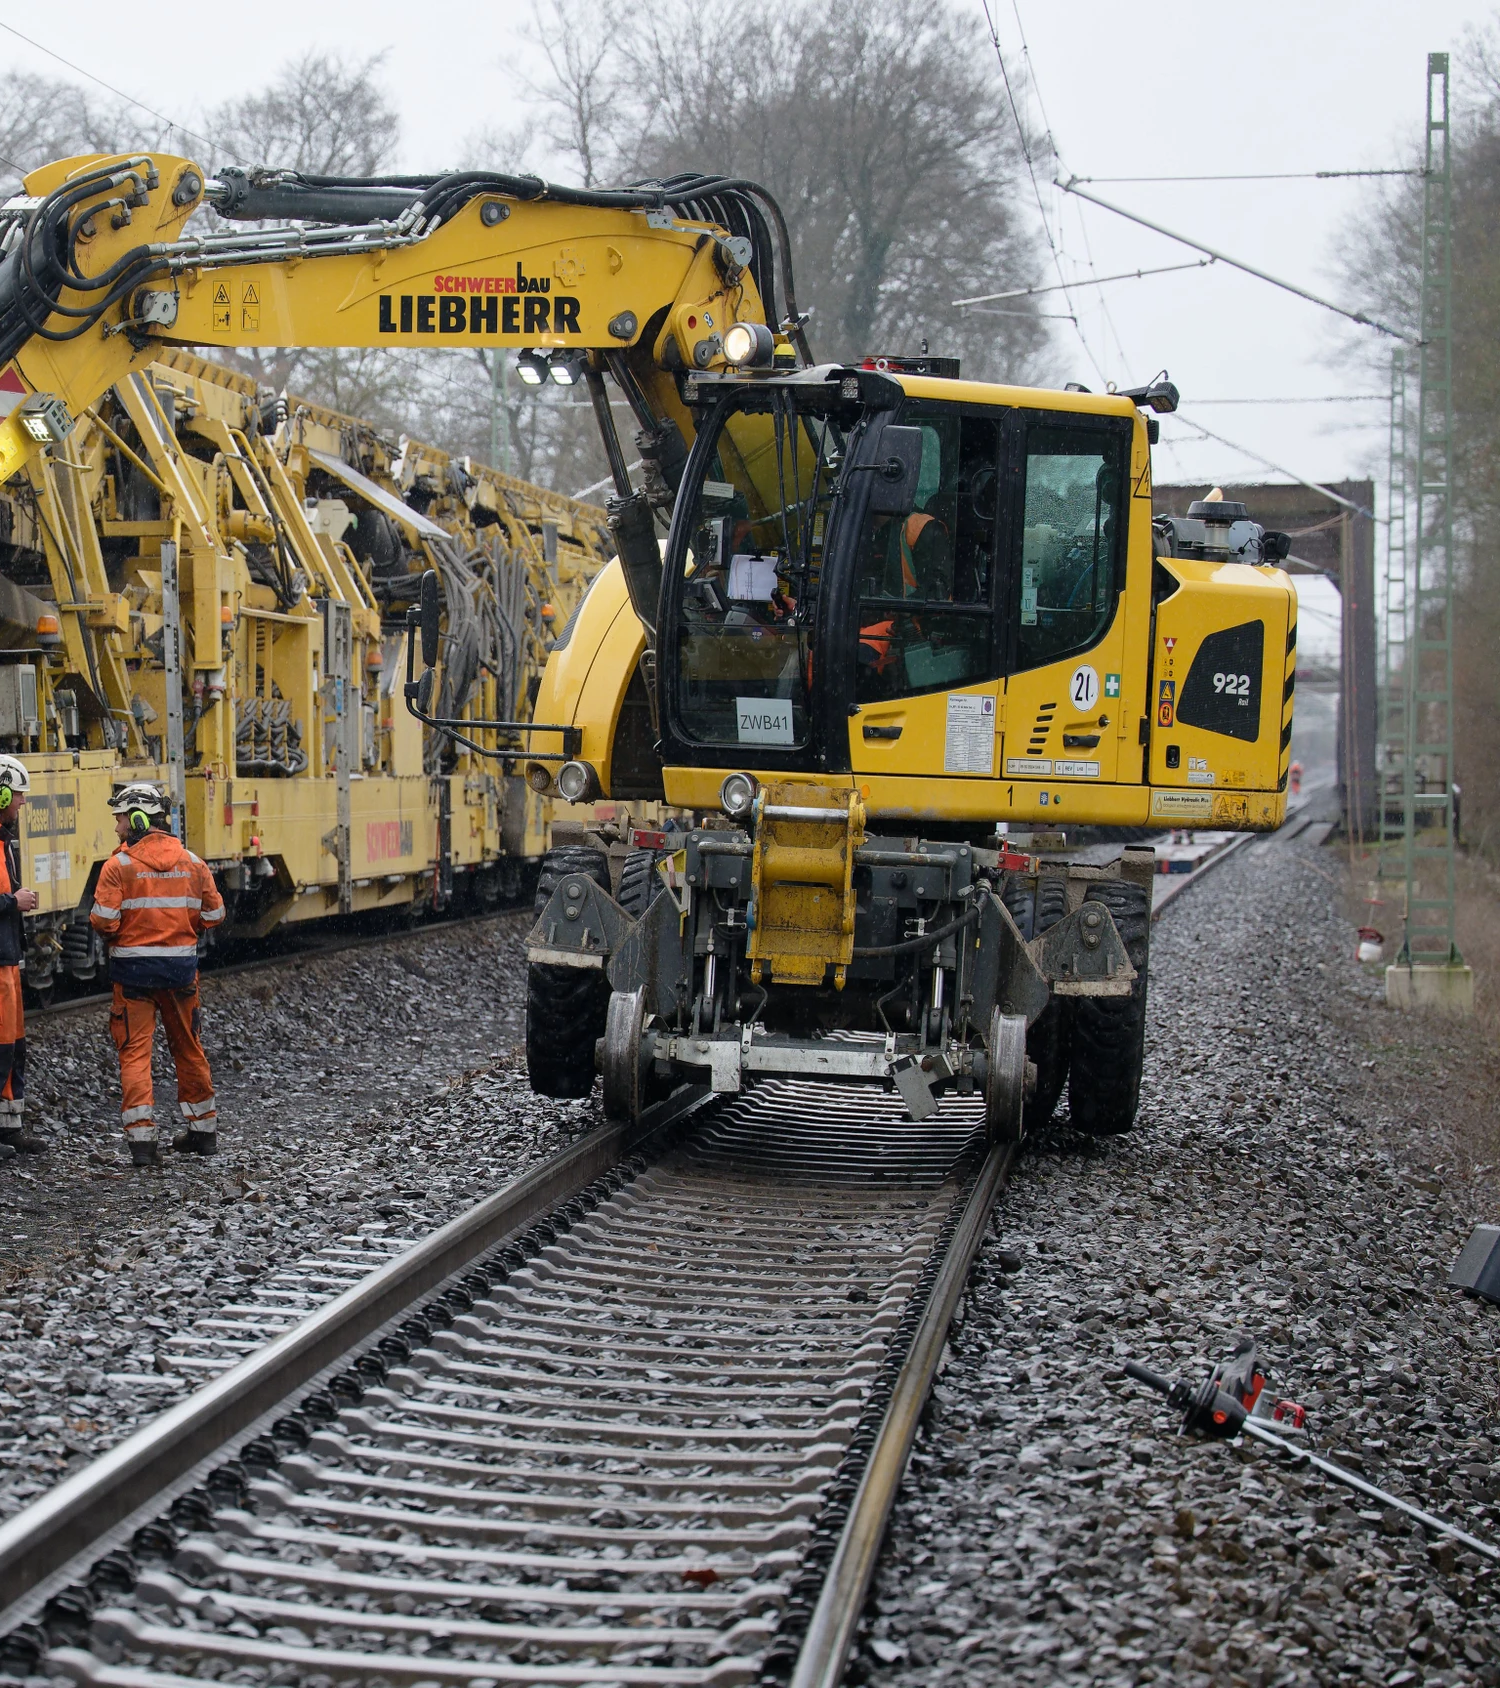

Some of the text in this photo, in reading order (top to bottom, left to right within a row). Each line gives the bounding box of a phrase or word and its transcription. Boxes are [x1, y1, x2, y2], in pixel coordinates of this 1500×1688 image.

[379, 295, 581, 333] LIEBHERR
[1213, 672, 1251, 696] 922
[1237, 698, 1249, 706] Rail
[740, 714, 788, 731] ZWB41
